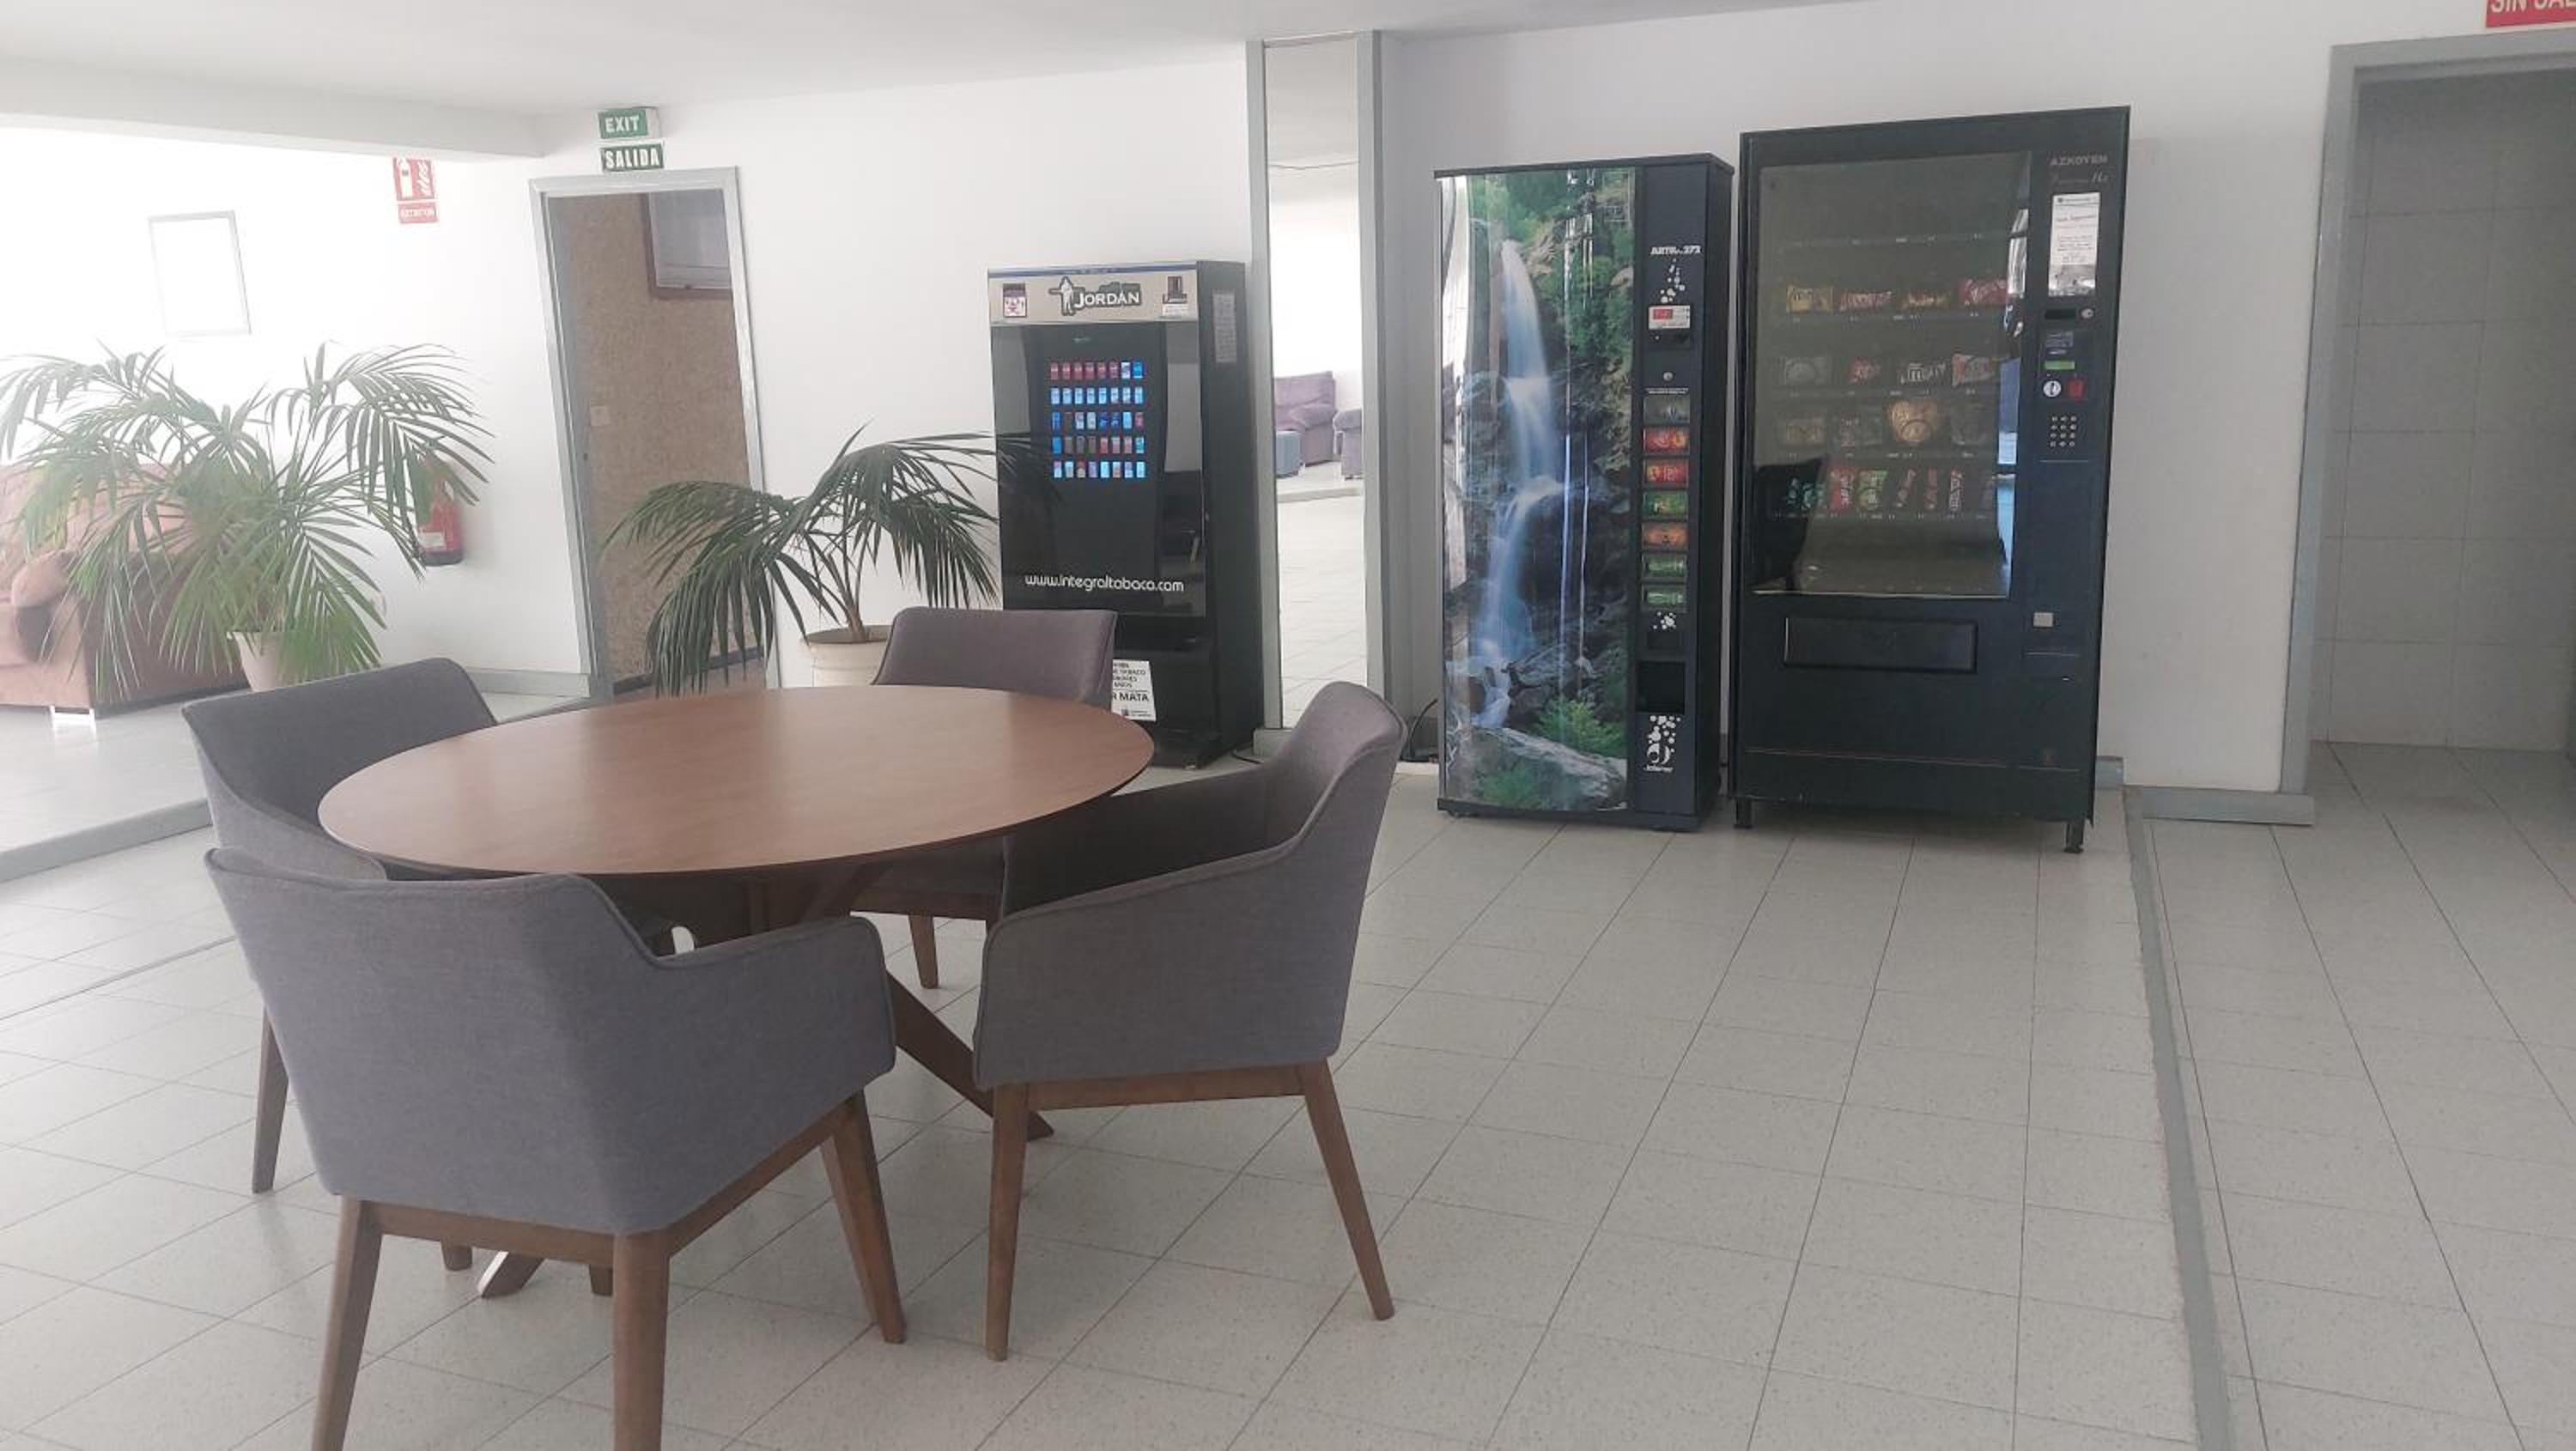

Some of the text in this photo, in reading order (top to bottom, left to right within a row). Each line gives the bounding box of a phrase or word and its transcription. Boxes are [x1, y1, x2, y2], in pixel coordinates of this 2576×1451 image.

[605, 115, 640, 133] EXIT
[605, 148, 660, 168] SALIDA
[1074, 291, 1139, 308] JORDAN
[1120, 691, 1149, 701] MATA
